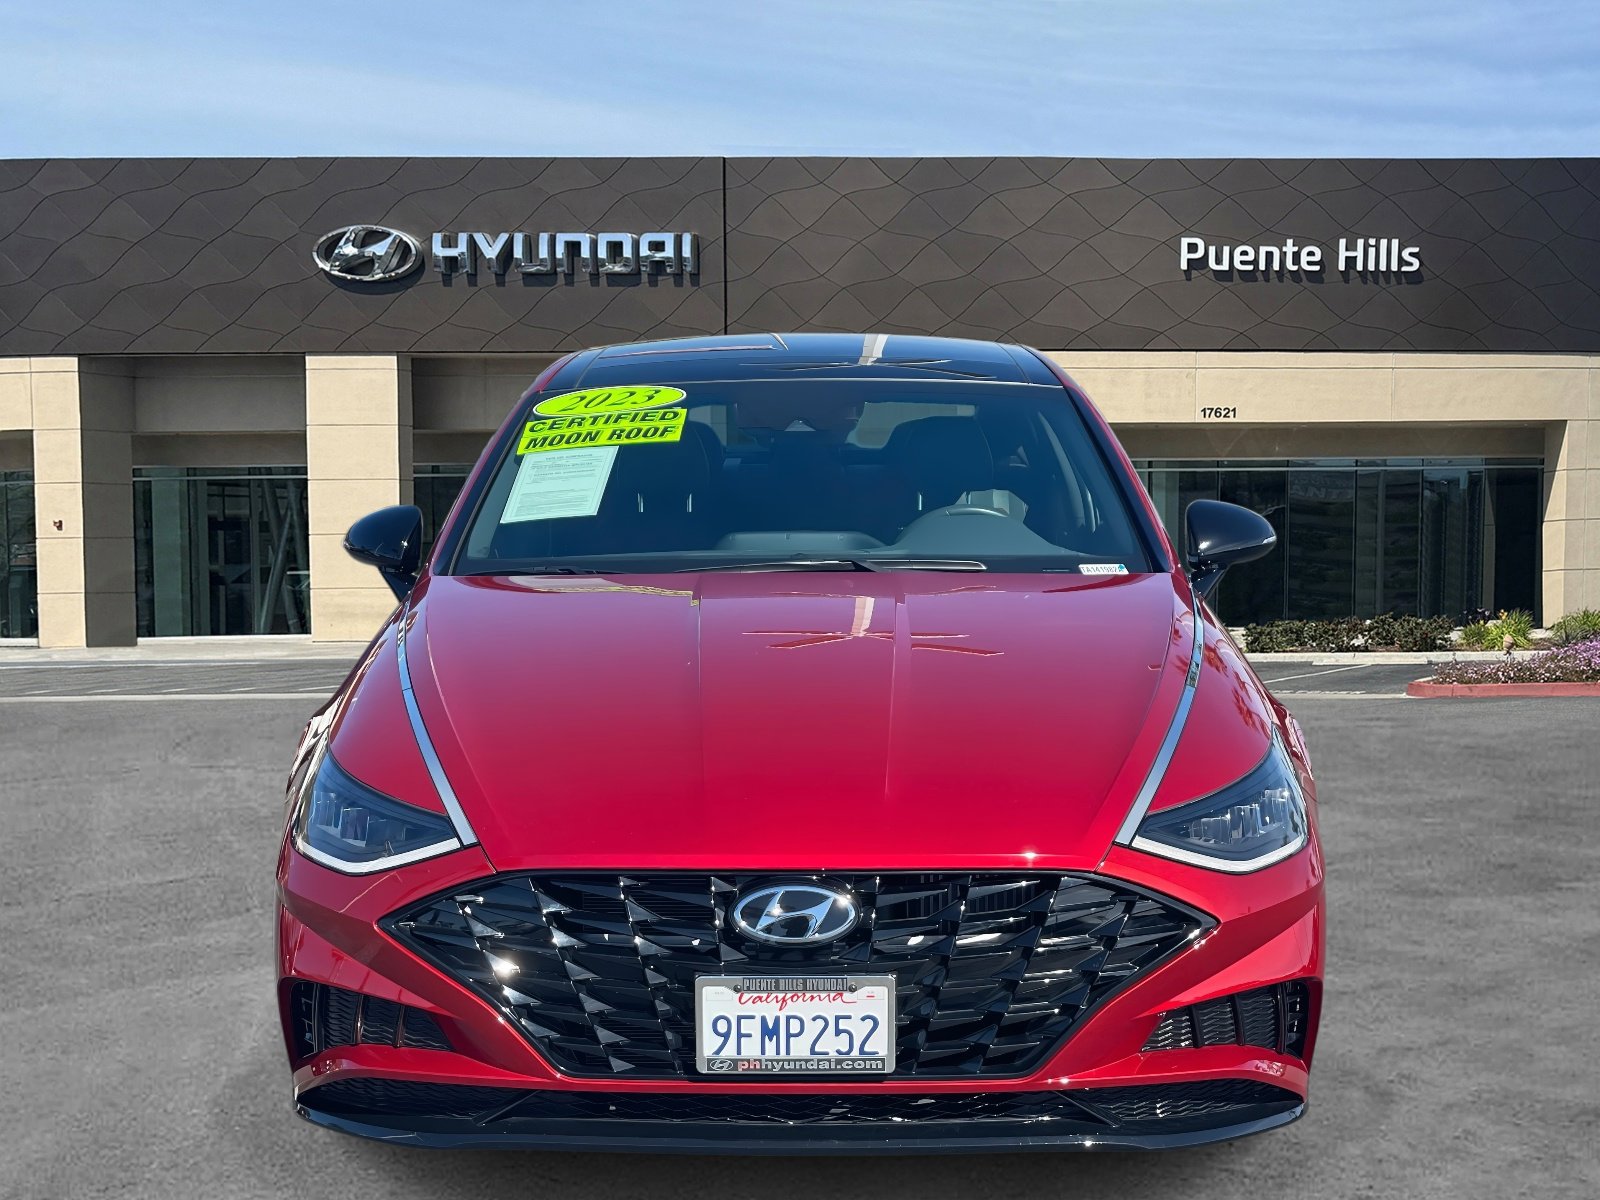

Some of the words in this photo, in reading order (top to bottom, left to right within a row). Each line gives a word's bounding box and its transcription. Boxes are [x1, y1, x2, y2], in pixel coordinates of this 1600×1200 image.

[432, 232, 700, 274] HYUNDAI
[1180, 237, 1322, 272] Puente
[1338, 238, 1421, 272] Hills
[557, 389, 661, 411] 2023
[528, 410, 681, 434] CERTIFIED
[1200, 407, 1237, 419] 17621
[525, 430, 601, 451] MOON
[607, 424, 677, 441] ROOF
[743, 978, 776, 991] PUENTE
[779, 978, 803, 991] HILLS
[806, 978, 849, 991] HYUNDAI
[738, 991, 857, 1011] California
[711, 1014, 880, 1056] 9FMP252
[738, 1058, 883, 1071] phhyundai.com
